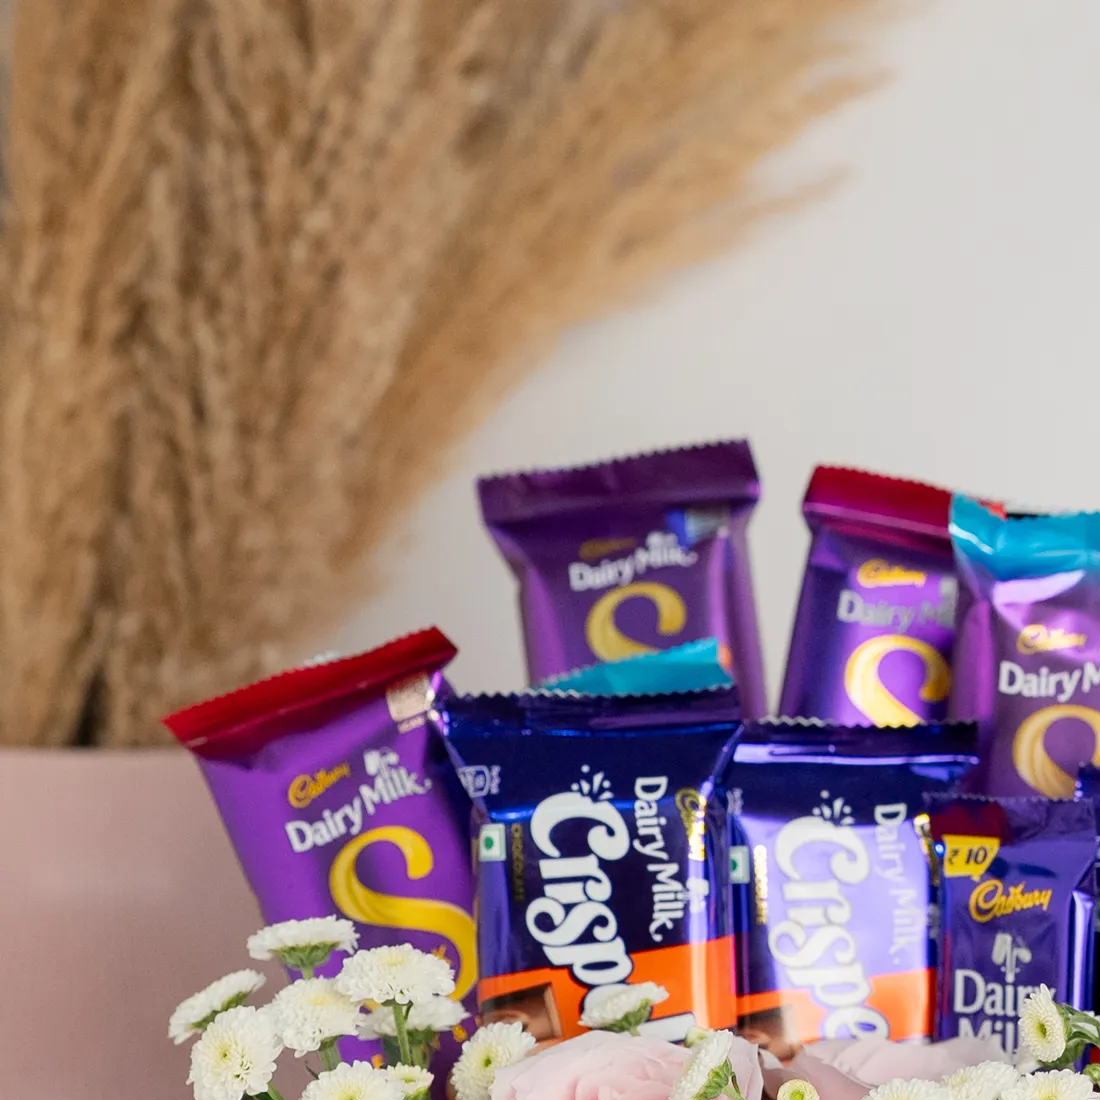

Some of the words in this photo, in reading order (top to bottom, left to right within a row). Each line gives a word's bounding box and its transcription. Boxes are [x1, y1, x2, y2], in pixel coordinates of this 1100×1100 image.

[837, 590, 916, 633] Dairy
[999, 661, 1083, 702] Dairy
[285, 797, 363, 853] Dairy
[359, 762, 433, 816] Milk
[633, 776, 671, 861] Dairy
[873, 802, 908, 882] Dairy
[647, 863, 686, 943] Milk
[887, 888, 926, 965] Milk
[969, 879, 1052, 923] Cadbury
